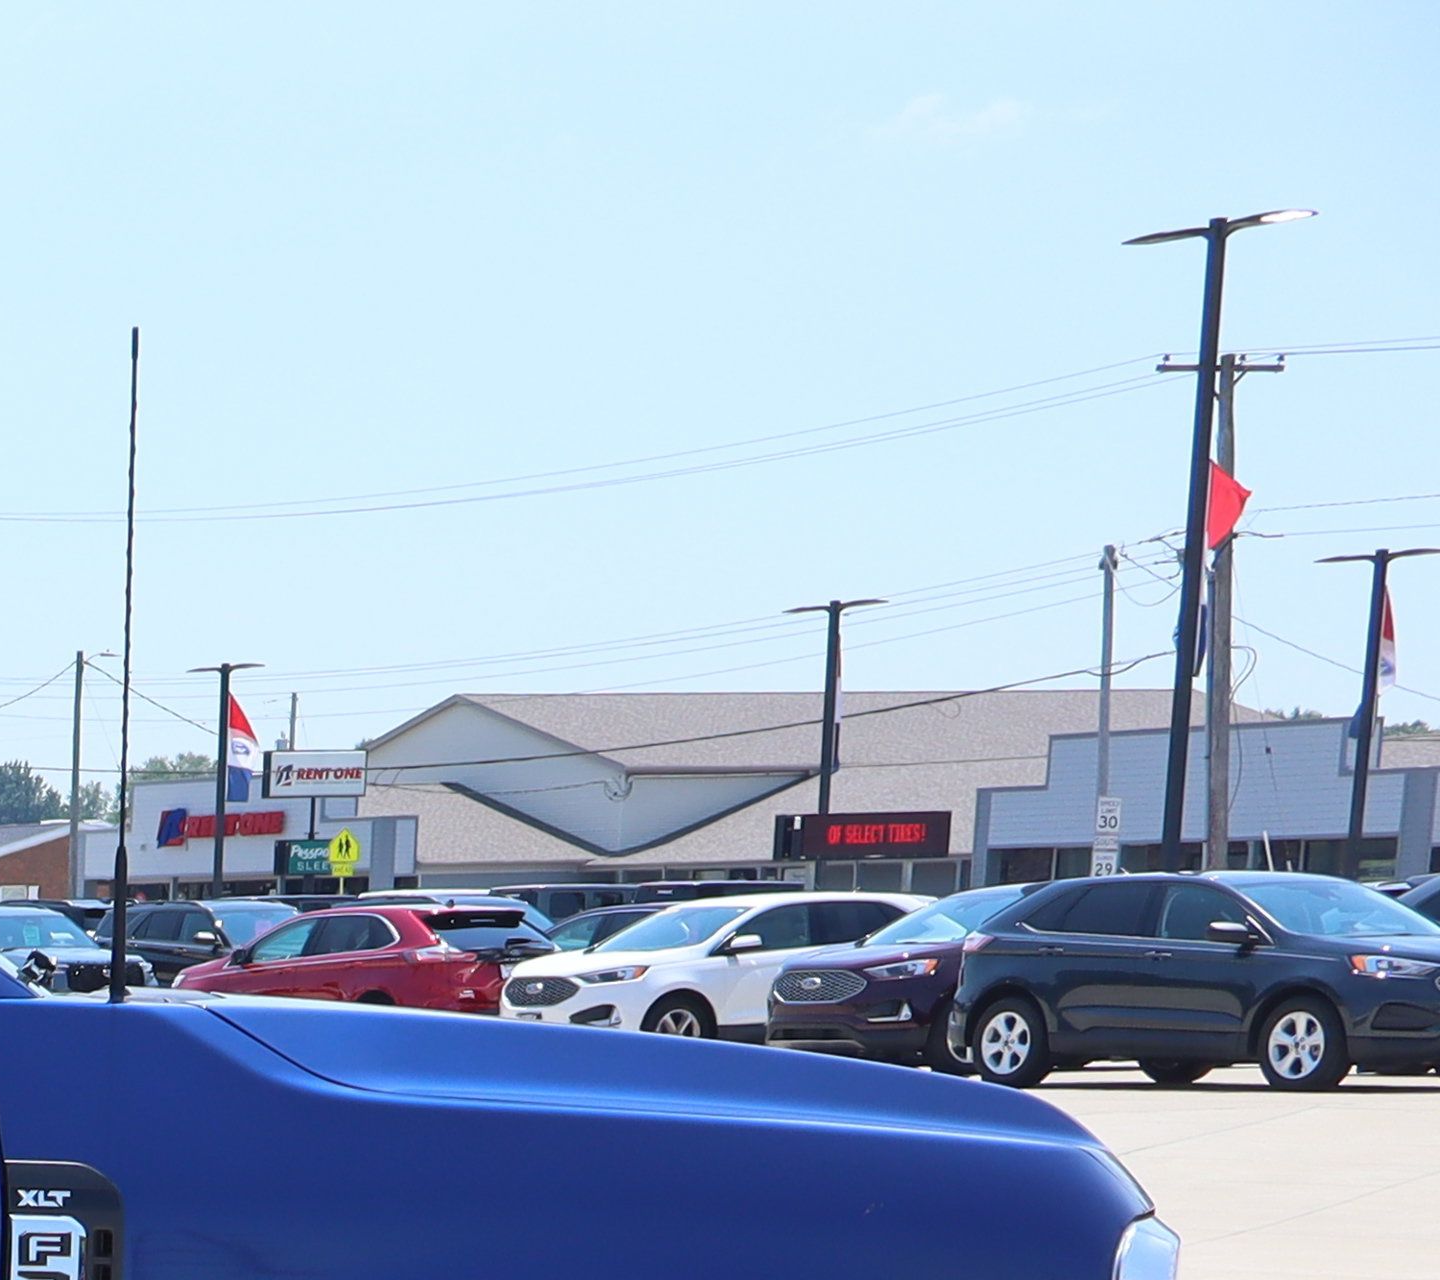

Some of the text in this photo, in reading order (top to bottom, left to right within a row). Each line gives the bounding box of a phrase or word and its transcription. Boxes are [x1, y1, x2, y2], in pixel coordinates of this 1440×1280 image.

[296, 767, 362, 781] RENT ONE
[240, 811, 284, 836] ONE
[1098, 815, 1118, 829] 30
[828, 823, 927, 844] OF SELECT TIRES!
[290, 844, 330, 860] Passpo
[297, 861, 329, 872] SLEE
[1094, 862, 1113, 876] 29
[17, 1189, 71, 1207] XLT
